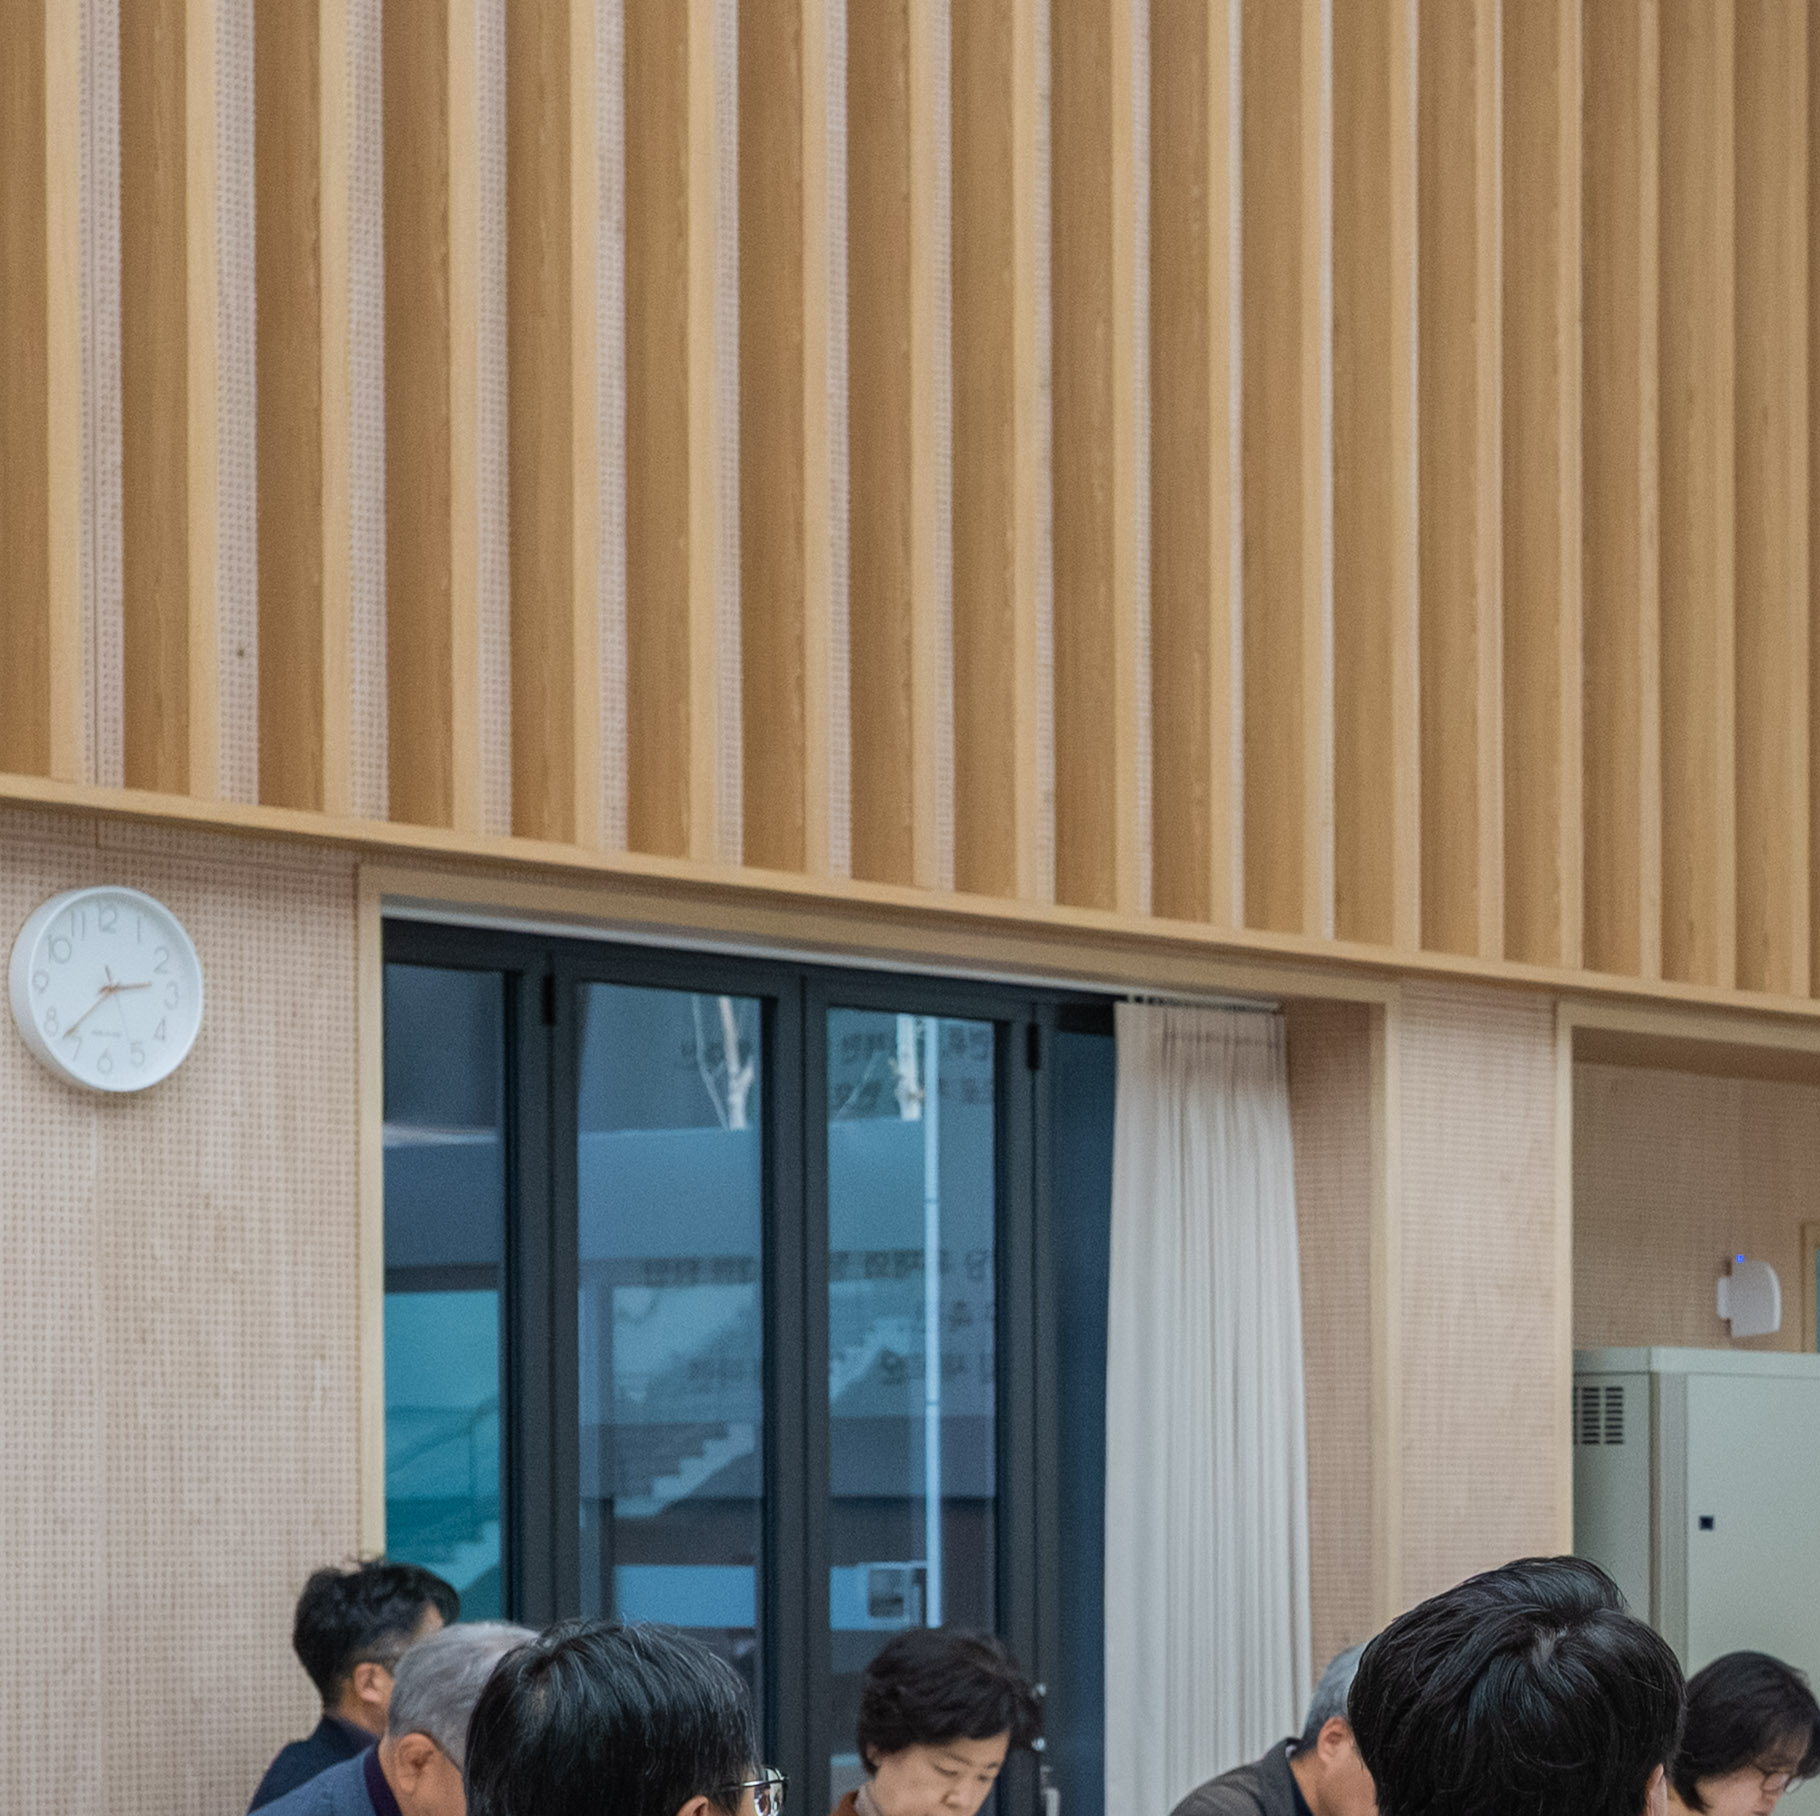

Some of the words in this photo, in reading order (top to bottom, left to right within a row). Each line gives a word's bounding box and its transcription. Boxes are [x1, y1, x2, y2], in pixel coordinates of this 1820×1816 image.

[70, 909, 86, 941] 11
[98, 901, 118, 934] 12
[47, 934, 73, 964] 10
[154, 946, 169, 975] 2
[32, 969, 49, 995] 9
[164, 981, 179, 1011] 3
[43, 1006, 59, 1038] 8
[153, 1016, 167, 1042] 4
[69, 1036, 83, 1062] 7
[96, 1048, 113, 1074] 6
[129, 1041, 146, 1067] 5
